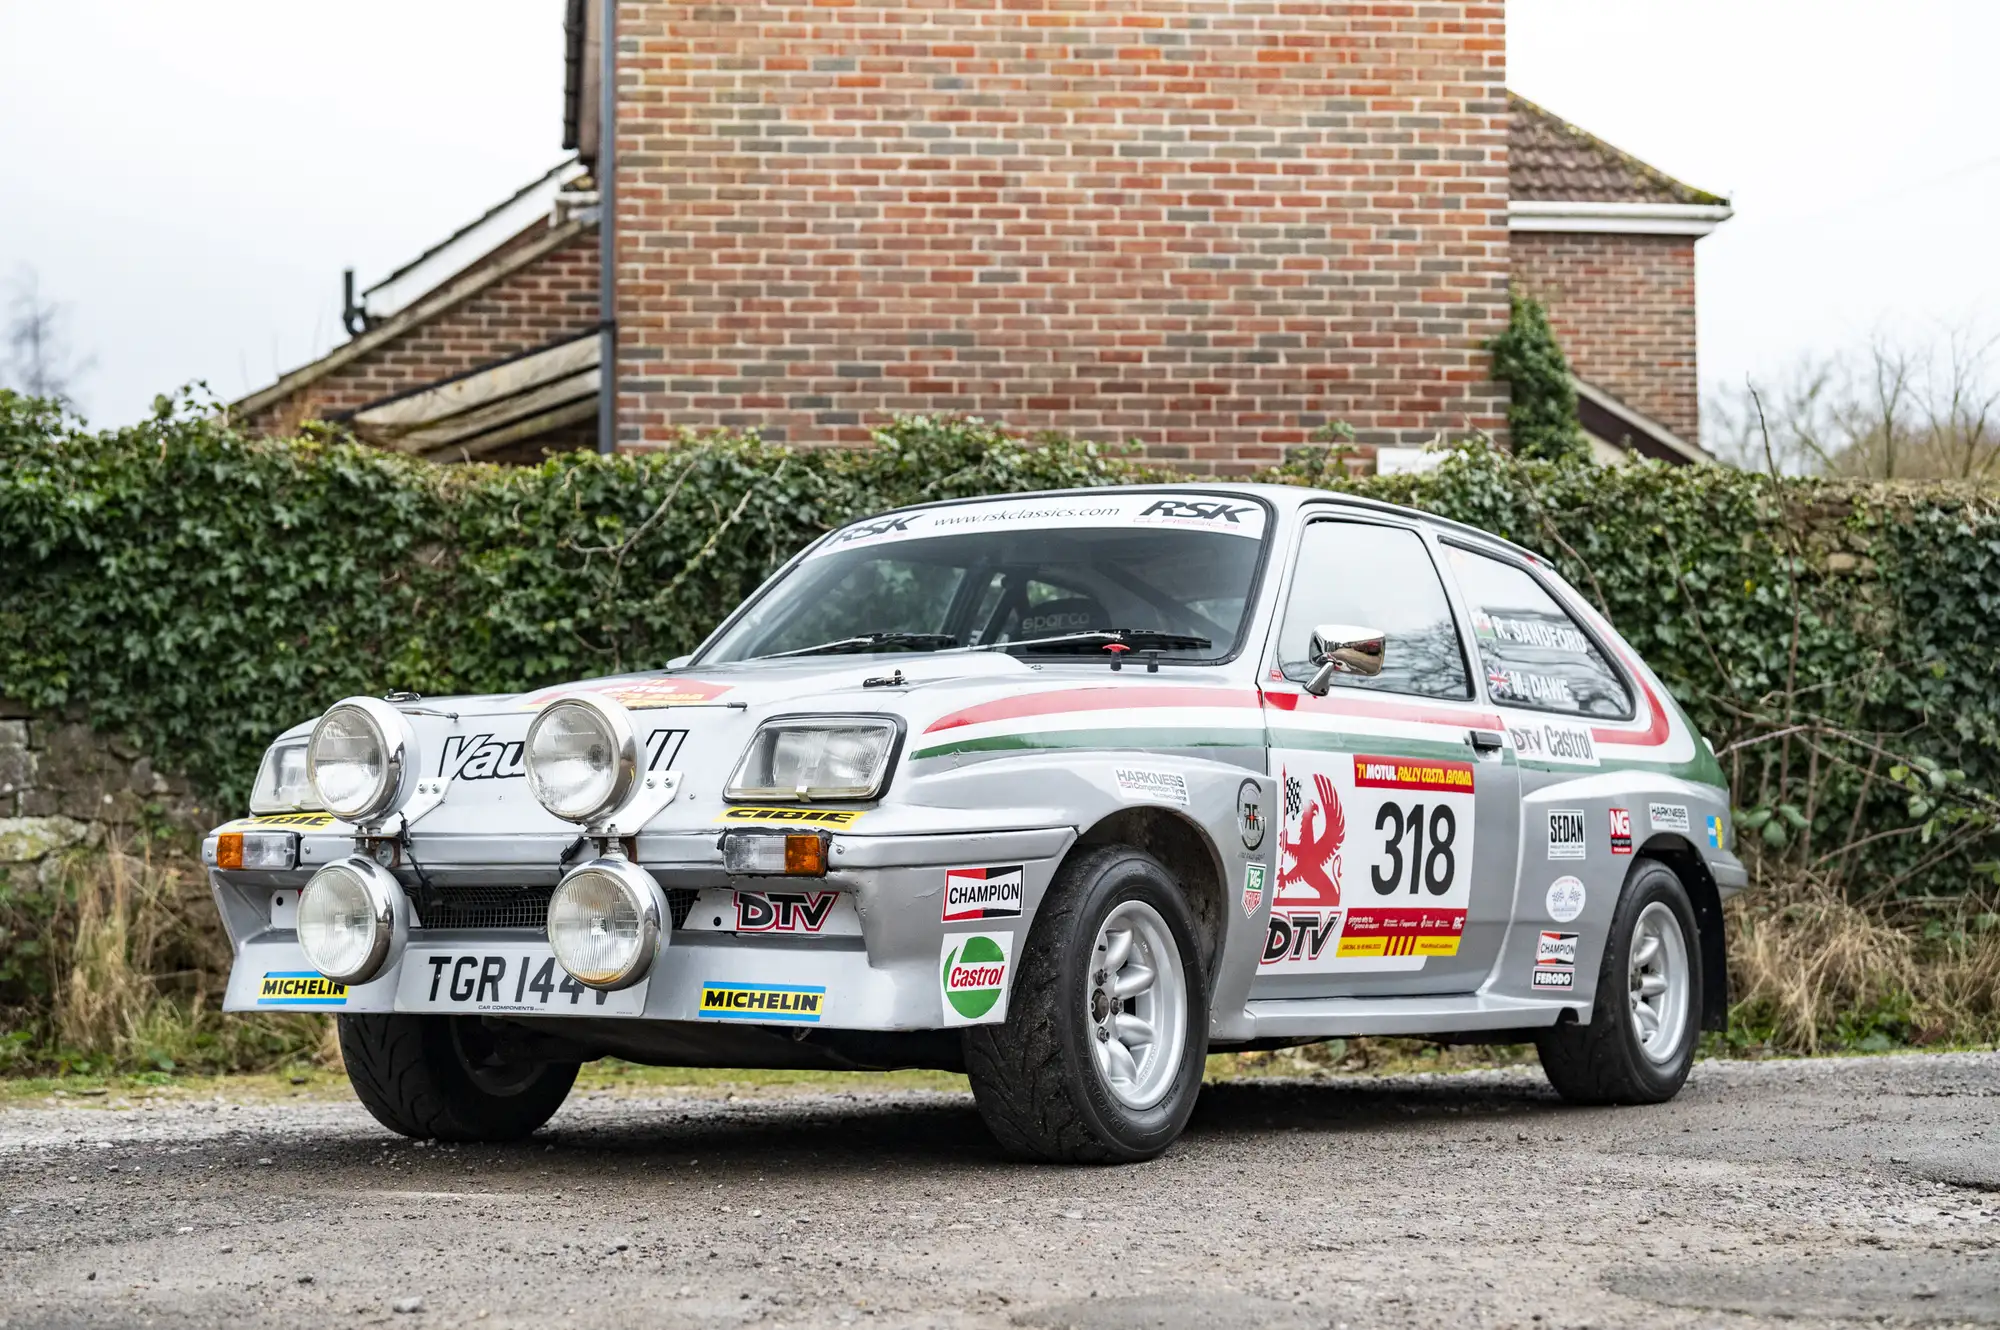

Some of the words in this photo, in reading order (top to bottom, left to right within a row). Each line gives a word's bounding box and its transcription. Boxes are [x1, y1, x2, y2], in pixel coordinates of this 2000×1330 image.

[934, 506, 1120, 527] www.rskclassics.com
[1139, 500, 1259, 523] RSK
[826, 514, 926, 547] RSK
[1022, 612, 1090, 632] sparco
[1492, 615, 1511, 641] R.
[1510, 620, 1588, 654] SANDFORD
[1510, 670, 1528, 699] M.
[1529, 674, 1571, 702] DAWE
[1509, 727, 1543, 754] DTV
[1544, 725, 1593, 759] Castrol
[439, 729, 690, 781] Vaull
[1115, 769, 1184, 787] HARKNESS
[1397, 766, 1421, 782] RALLY
[1422, 767, 1444, 784] COSTA
[1134, 783, 1170, 792] Competition
[1170, 786, 1187, 795] Tyres
[726, 809, 854, 824] CIBIE
[1610, 810, 1630, 835] NG
[1651, 806, 1686, 818] HARKNESS
[1550, 815, 1584, 843] SEDAN
[1371, 801, 1456, 896] 318
[1249, 870, 1261, 888] TAG
[948, 882, 1020, 906] CHAMPION
[733, 890, 841, 932] DTV
[1259, 911, 1342, 964] DTV
[1540, 942, 1575, 955] CHAMPION
[261, 978, 346, 996] MICHELIN
[428, 956, 507, 1002] TGR
[950, 964, 1005, 989] Castrol
[1535, 972, 1571, 985] FERODO
[492, 1004, 535, 1012] COMPONENTS
[704, 990, 822, 1012] MICHELIN
